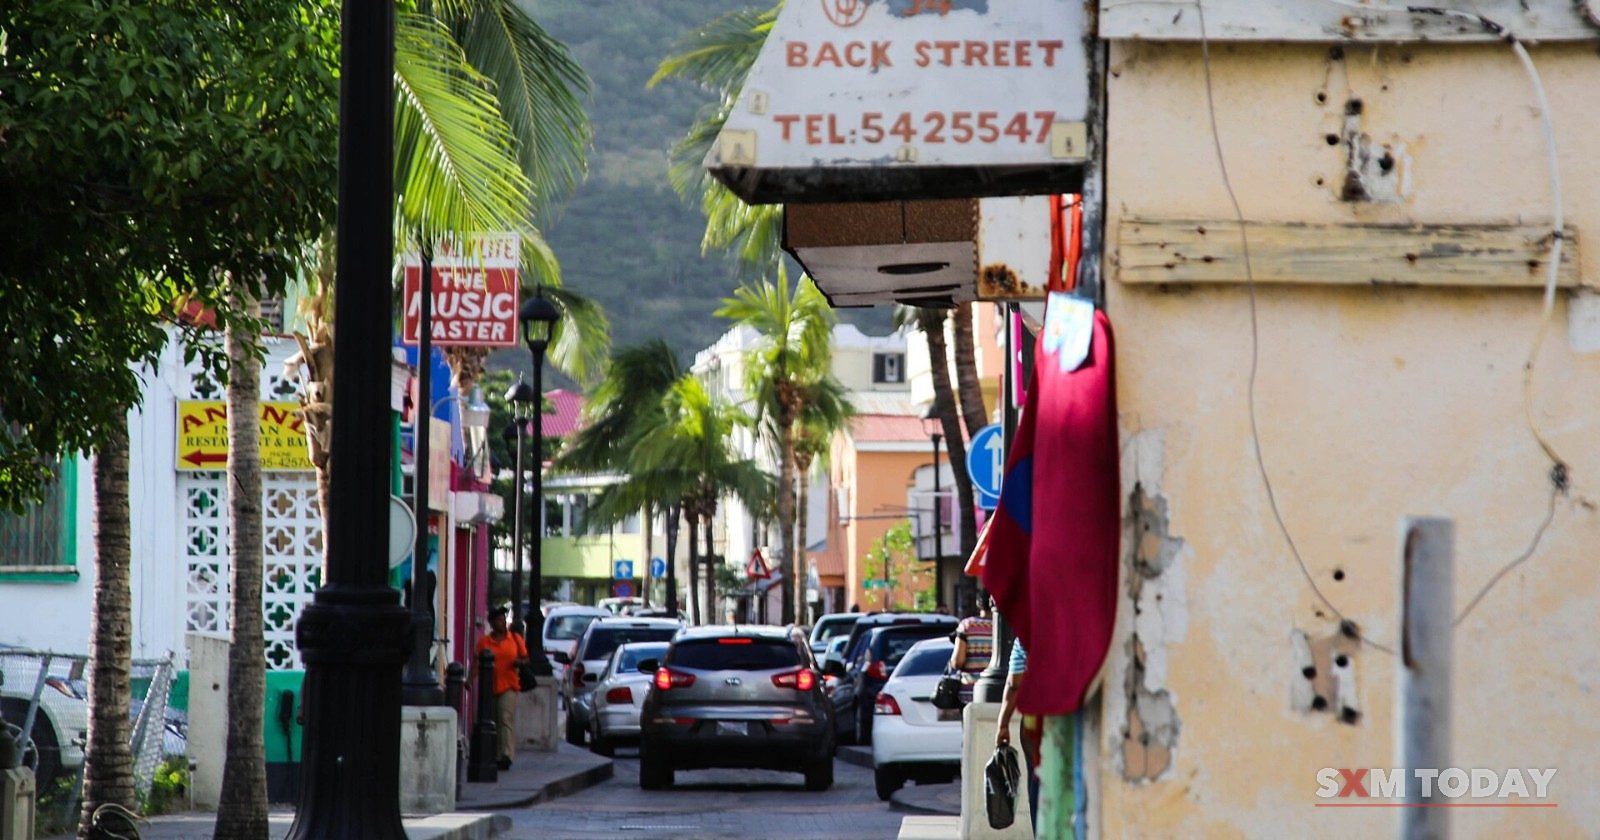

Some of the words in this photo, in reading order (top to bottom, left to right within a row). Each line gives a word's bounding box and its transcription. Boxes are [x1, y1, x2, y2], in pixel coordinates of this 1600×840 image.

[785, 40, 893, 67] BACK
[914, 40, 1064, 67] STREET
[439, 271, 486, 290] THE
